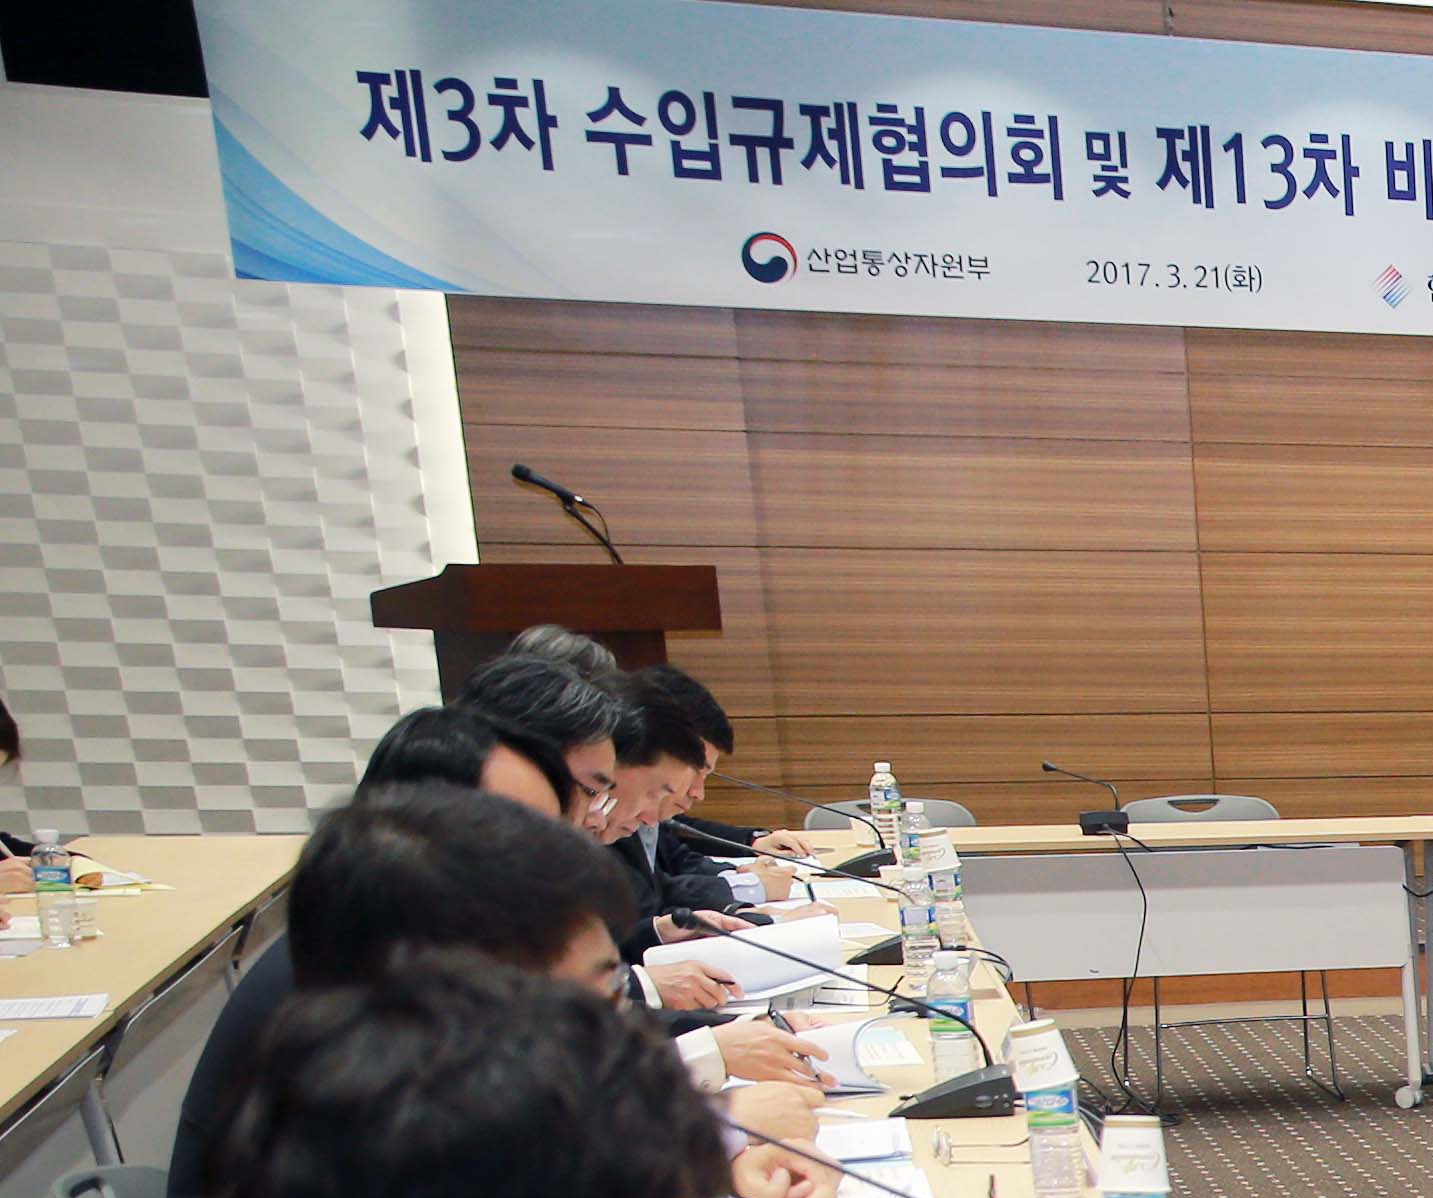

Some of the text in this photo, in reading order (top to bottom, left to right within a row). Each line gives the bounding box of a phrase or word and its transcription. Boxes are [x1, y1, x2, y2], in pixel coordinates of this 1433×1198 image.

[356, 69, 560, 173] 제3차
[585, 86, 1065, 202] 수입규제협의회
[1085, 130, 1133, 201] 및
[1155, 123, 1361, 218] 제13차
[807, 248, 991, 281] 산업통상자원부
